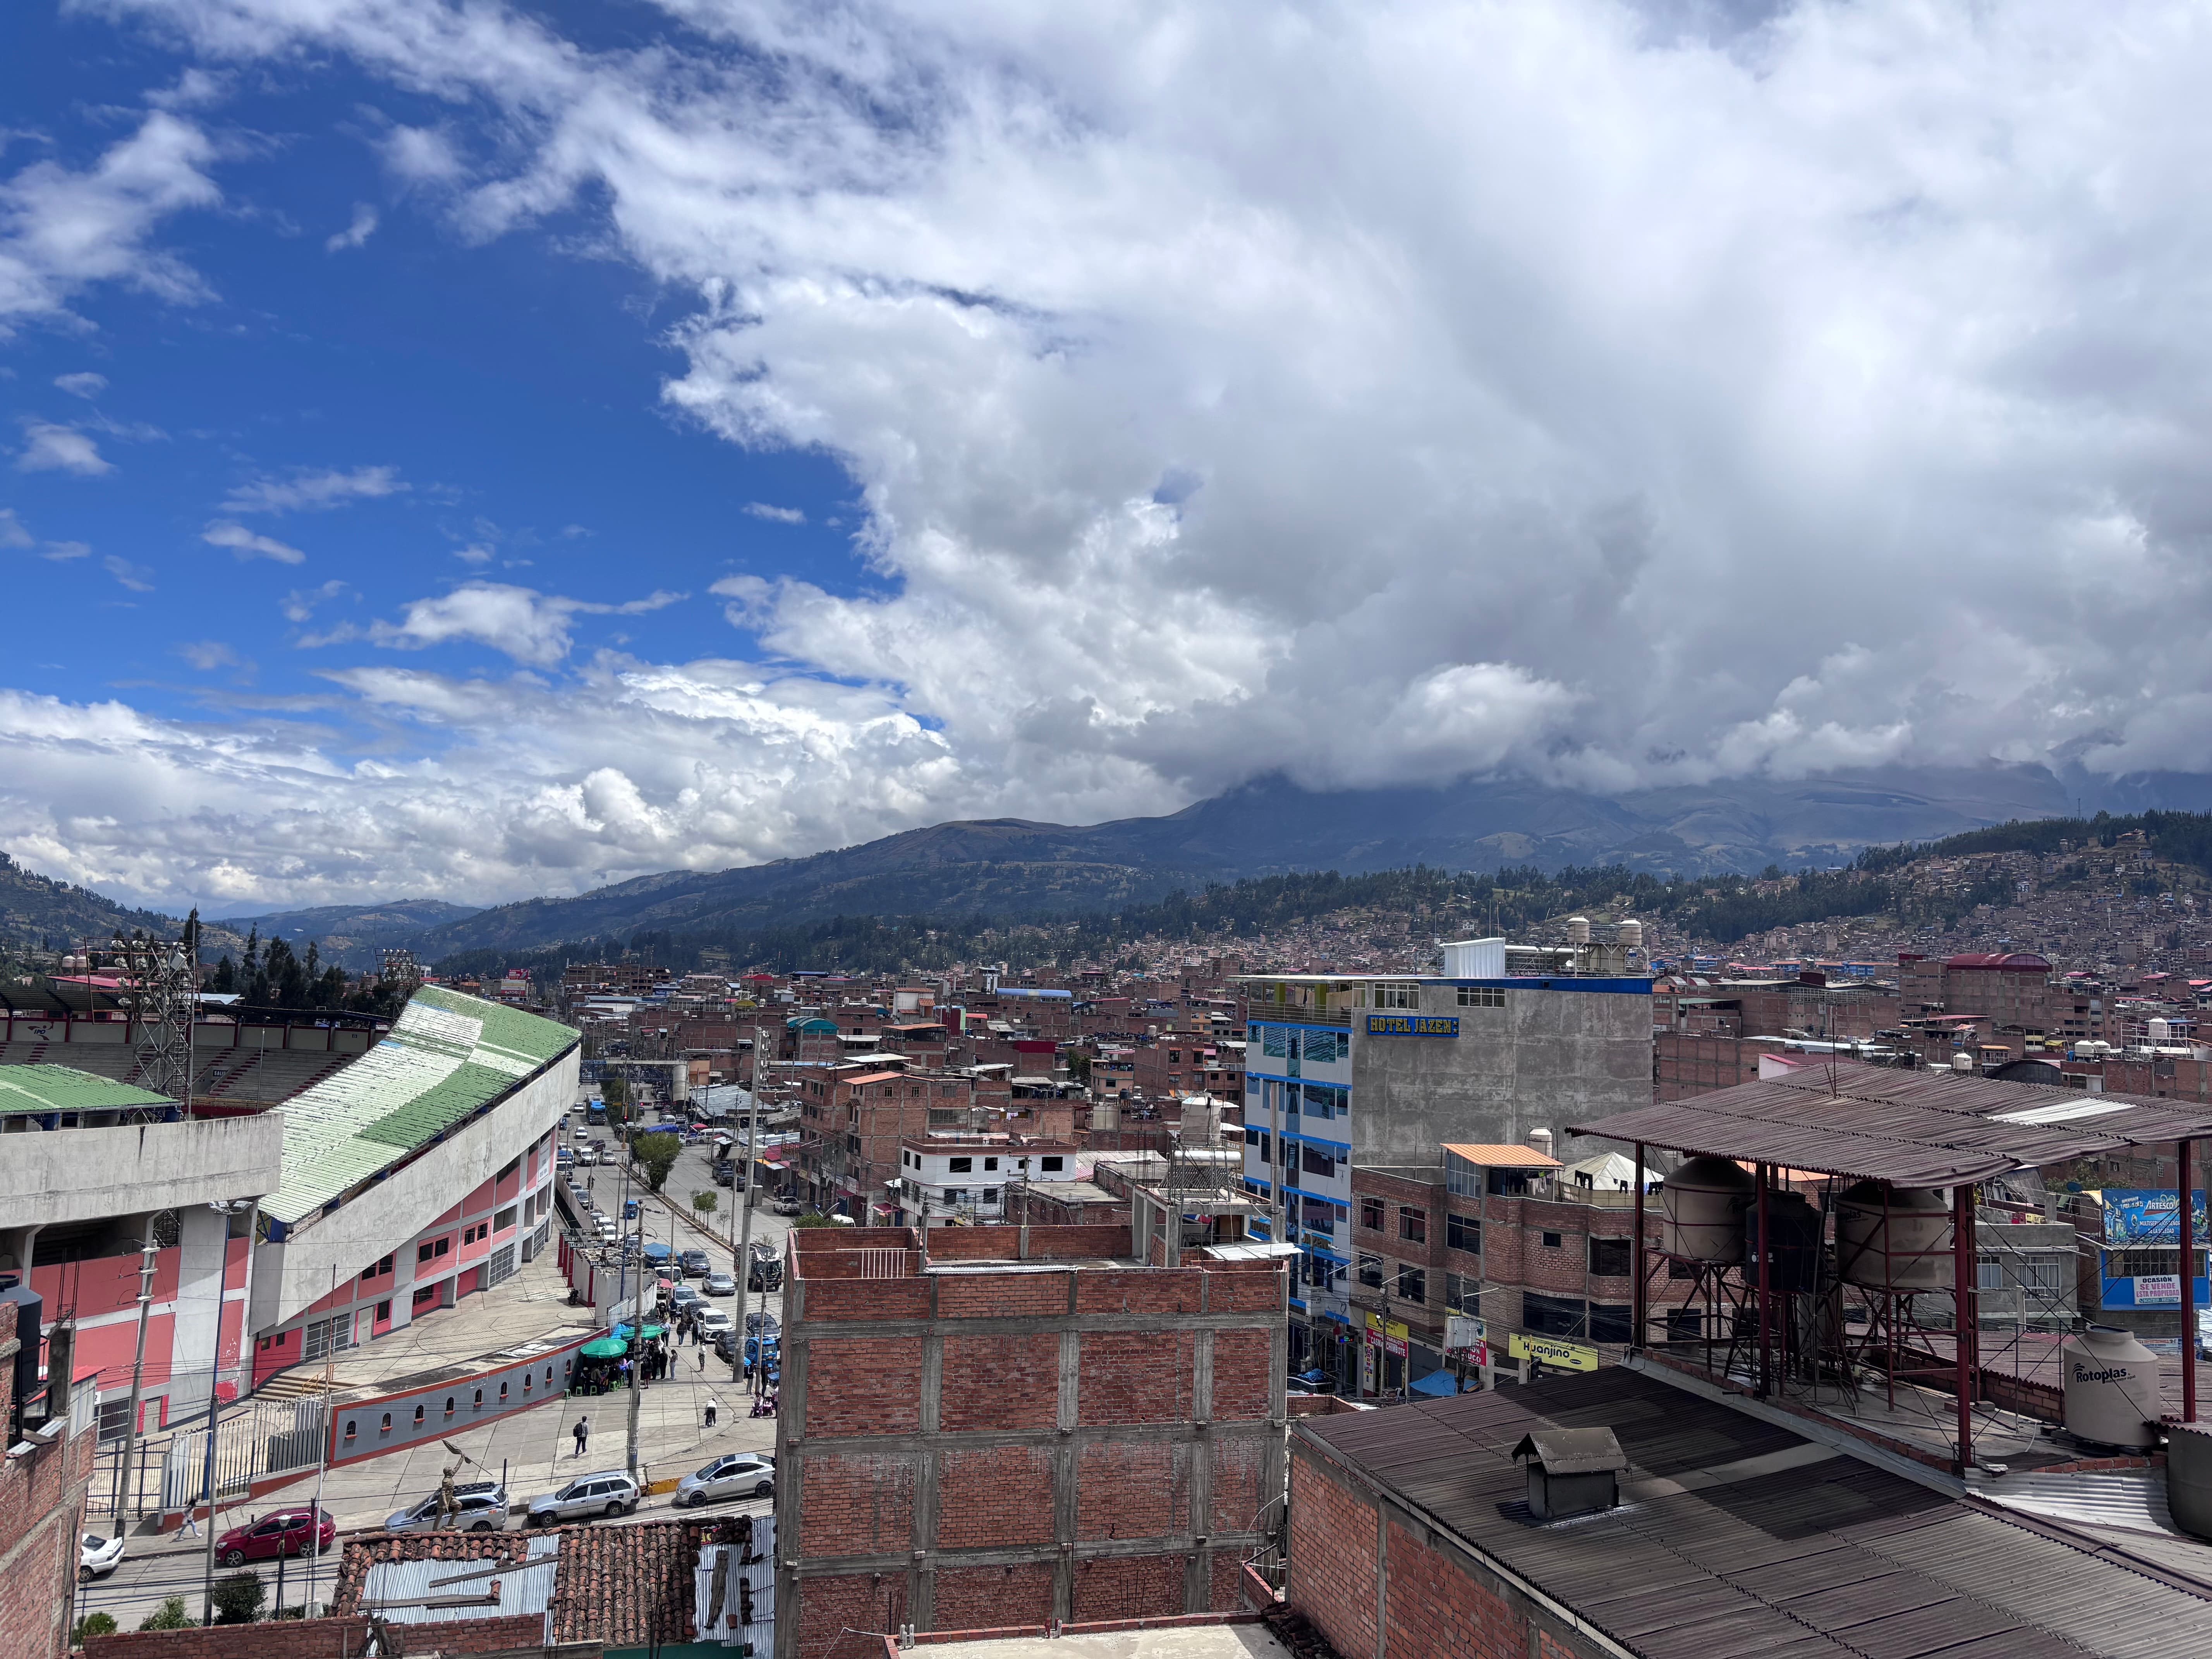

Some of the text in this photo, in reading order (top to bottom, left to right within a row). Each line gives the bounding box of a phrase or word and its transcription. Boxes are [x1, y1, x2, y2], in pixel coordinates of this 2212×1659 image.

[1370, 1017, 1451, 1034] HOTEL JAZEN
[2146, 1200, 2174, 1209] ARTESCO
[1251, 1220, 1271, 1236] HOTE
[1386, 1342, 1406, 1357] CHIMBOTE
[1523, 1342, 1570, 1358] Huanjino
[2076, 1368, 2127, 1384] Rotoplas
